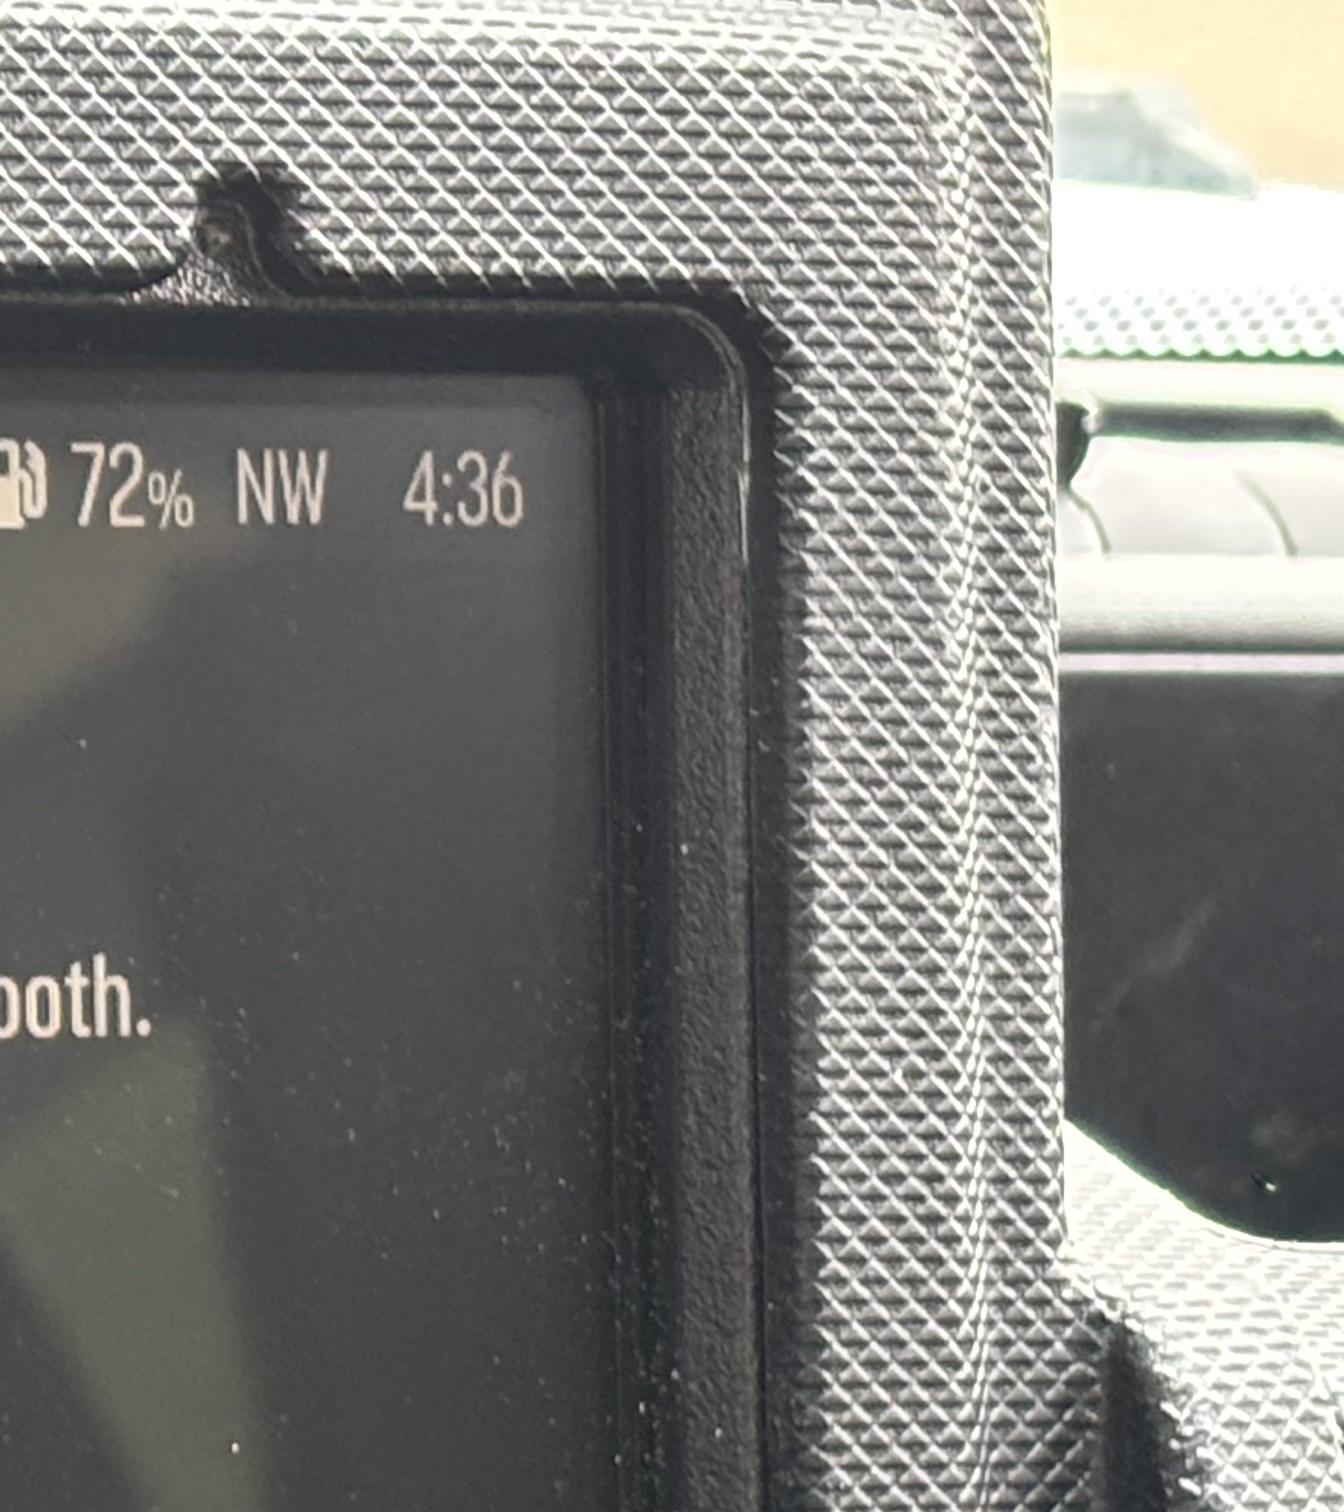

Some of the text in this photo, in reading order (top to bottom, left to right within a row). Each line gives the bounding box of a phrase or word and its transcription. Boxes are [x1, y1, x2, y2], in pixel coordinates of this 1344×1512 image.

[70, 442, 328, 529] 72% NW
[403, 450, 524, 527] 4:36
